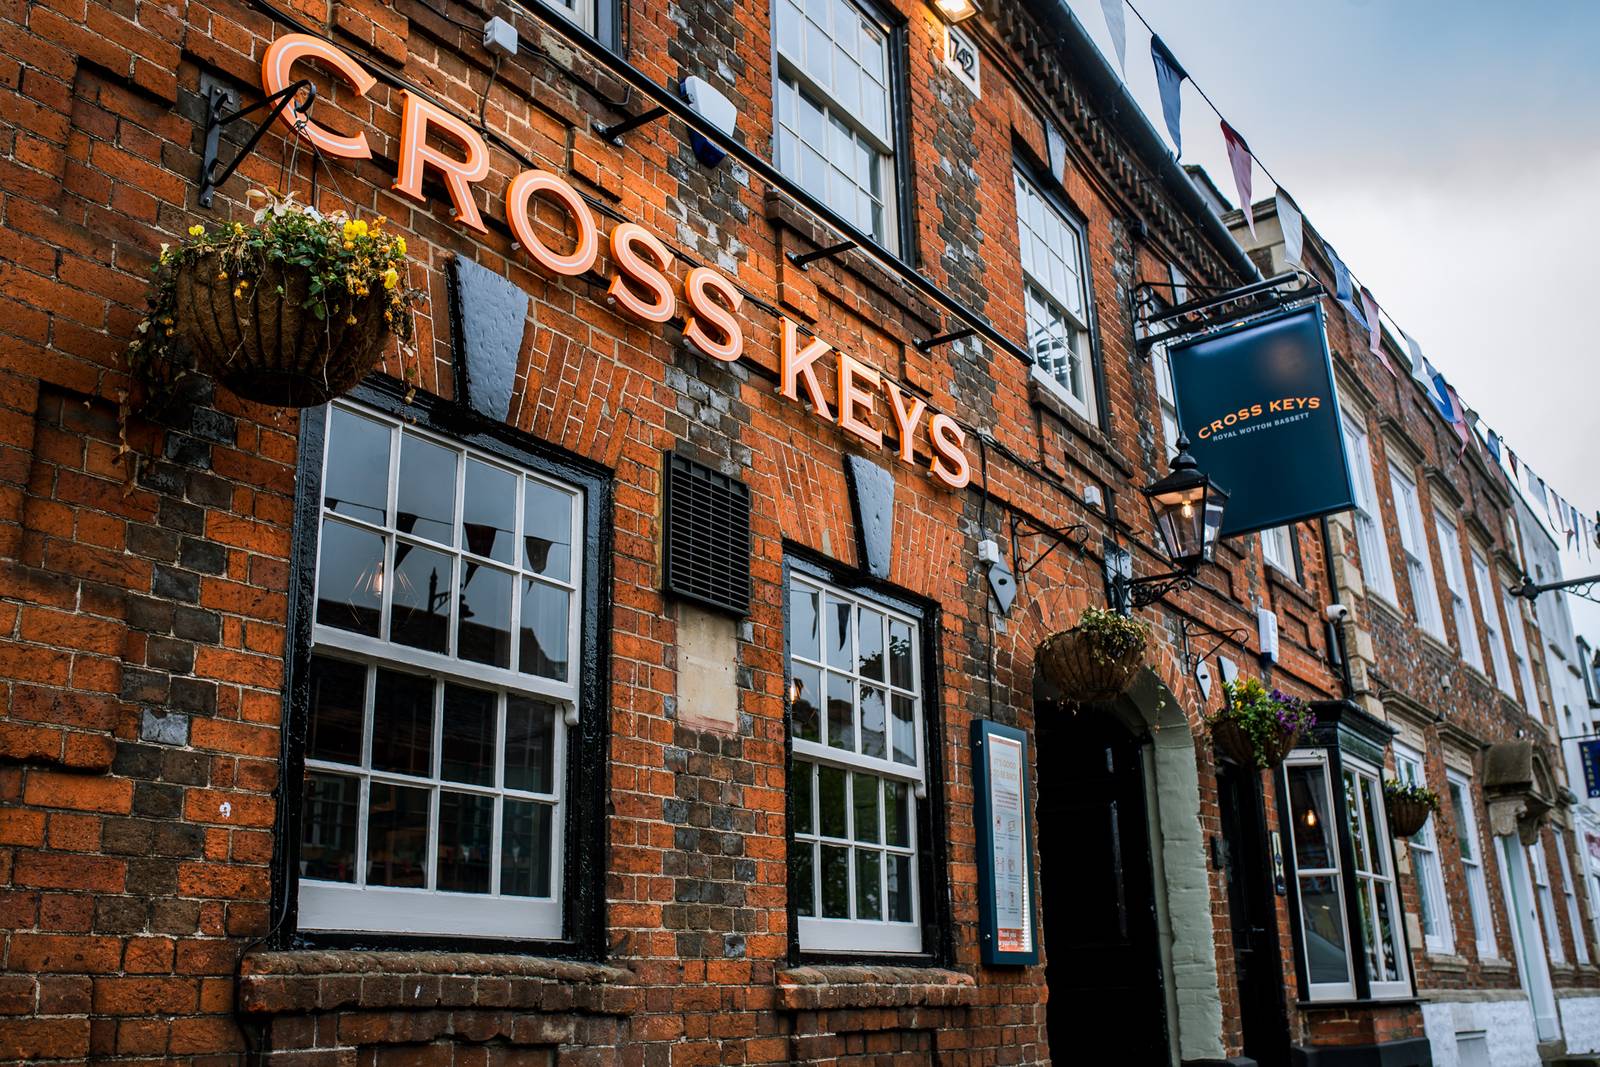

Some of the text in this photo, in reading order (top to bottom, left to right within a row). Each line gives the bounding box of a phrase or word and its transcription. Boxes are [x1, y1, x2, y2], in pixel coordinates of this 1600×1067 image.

[262, 33, 970, 489] CROSS KEYS
[1198, 397, 1321, 439] CROSS KEYS
[1213, 412, 1309, 441] ROYAL WOTTON BASSETT
